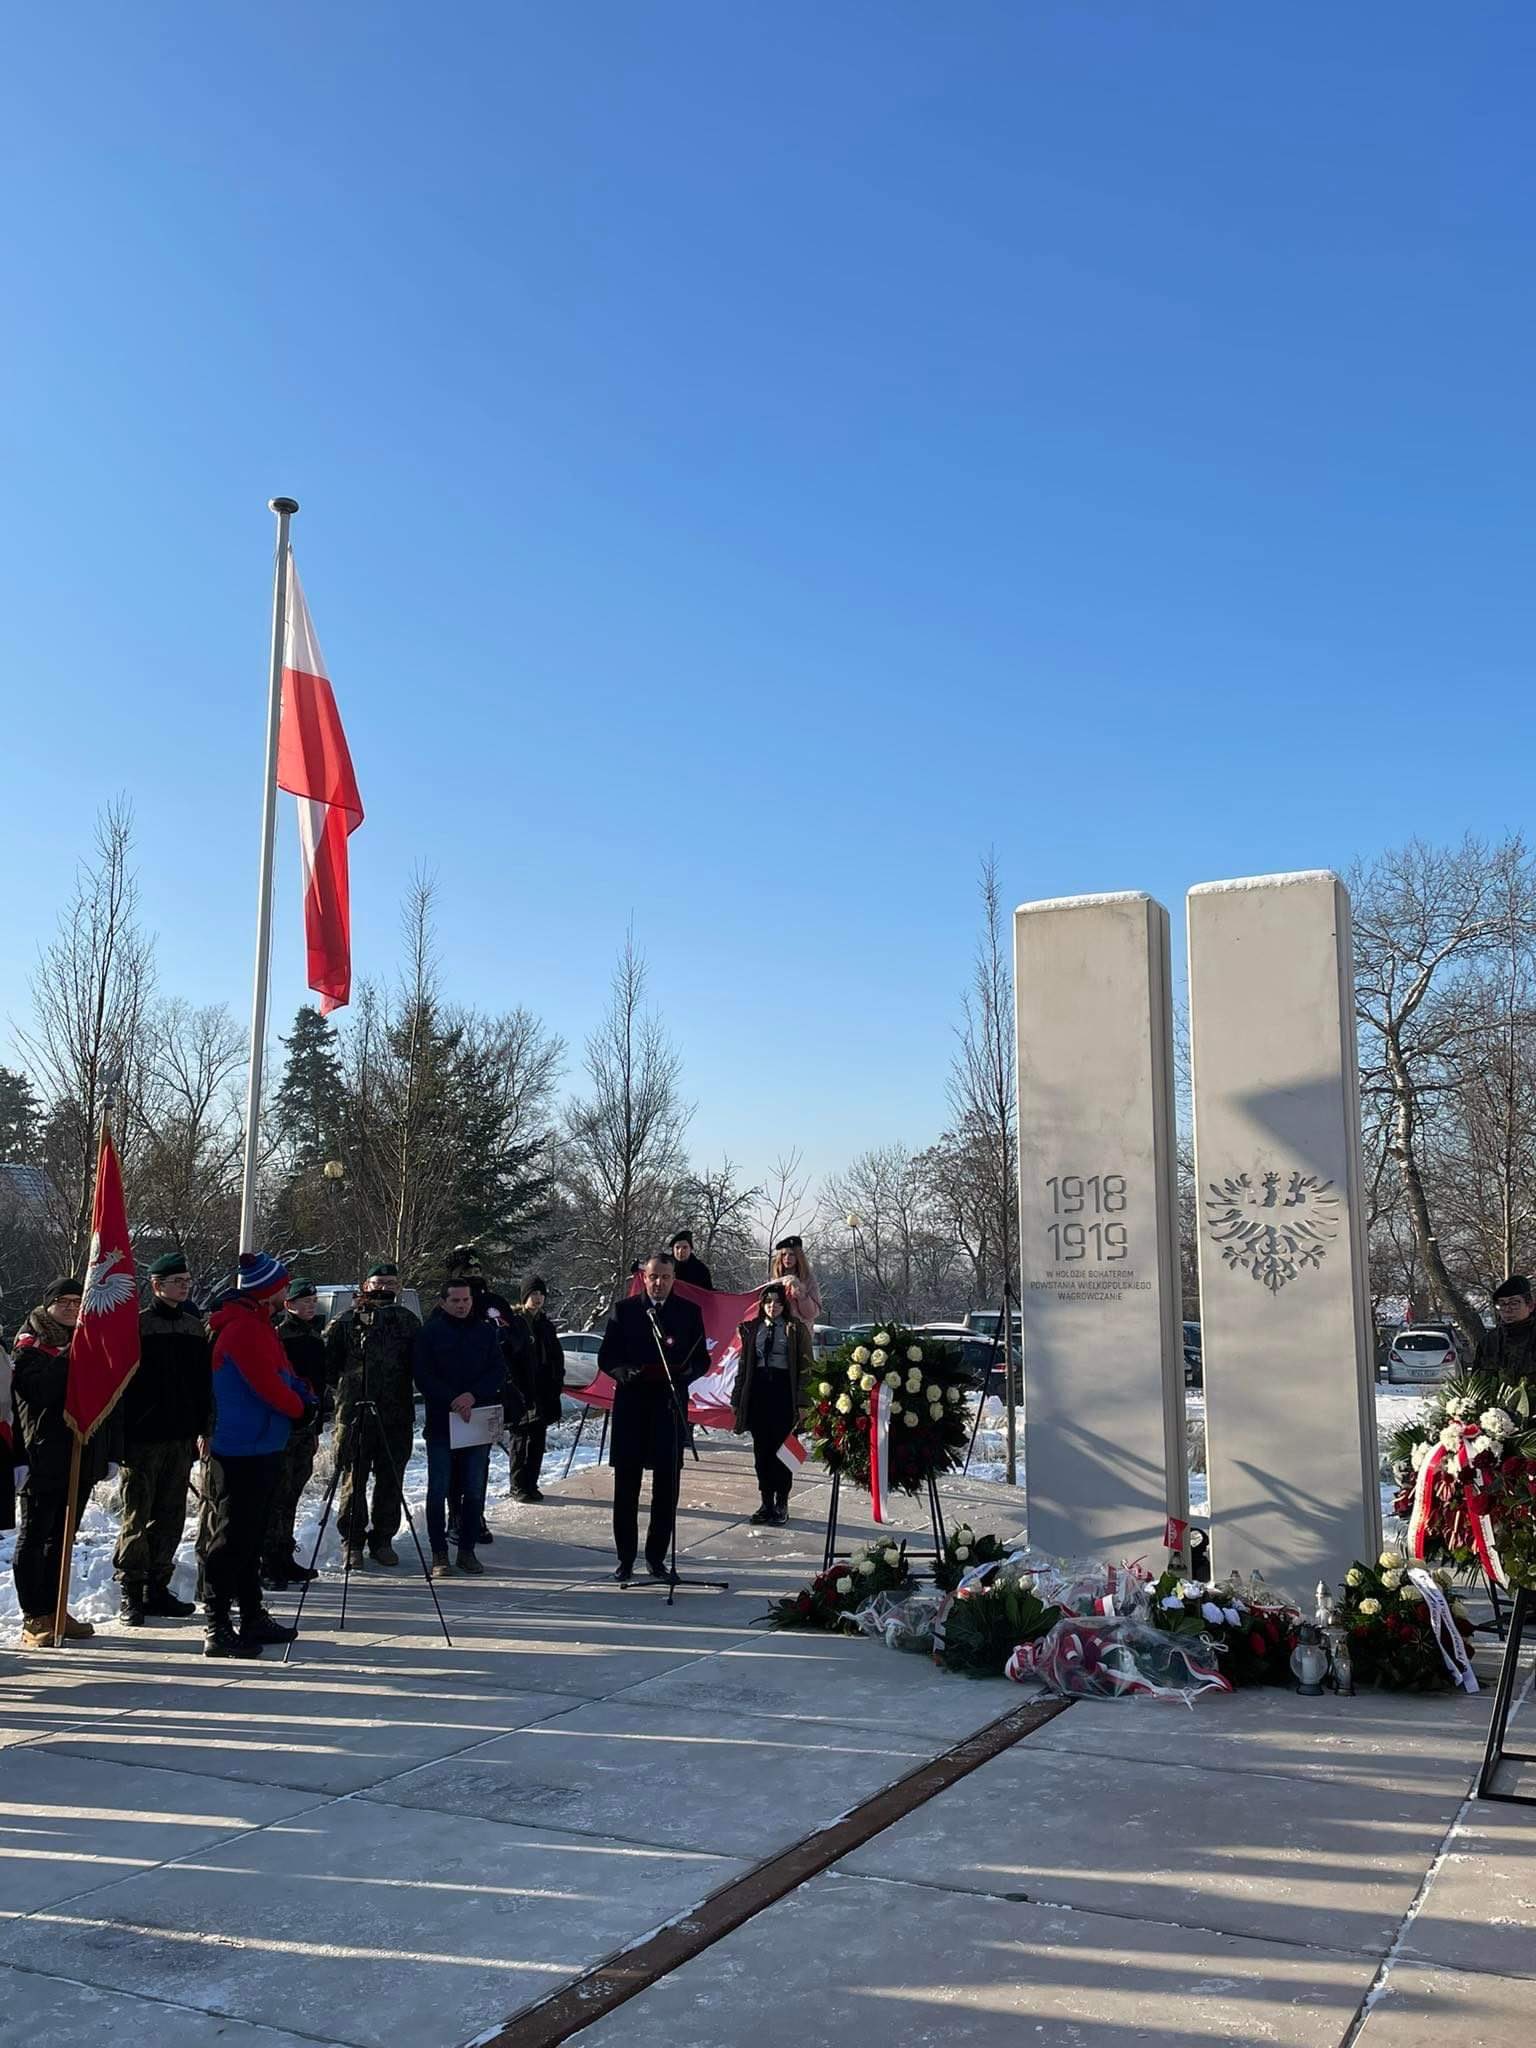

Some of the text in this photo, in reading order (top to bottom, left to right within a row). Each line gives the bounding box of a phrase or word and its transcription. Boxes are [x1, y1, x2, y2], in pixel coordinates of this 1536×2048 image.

[1046, 1175, 1127, 1214] 1918
[1047, 1222, 1128, 1261] 1919
[1030, 1281, 1152, 1290] POWSTANIA WIELKOPOLSKIEGO
[1046, 1270, 1053, 1278] W
[1088, 1270, 1134, 1278] BOHATEROM
